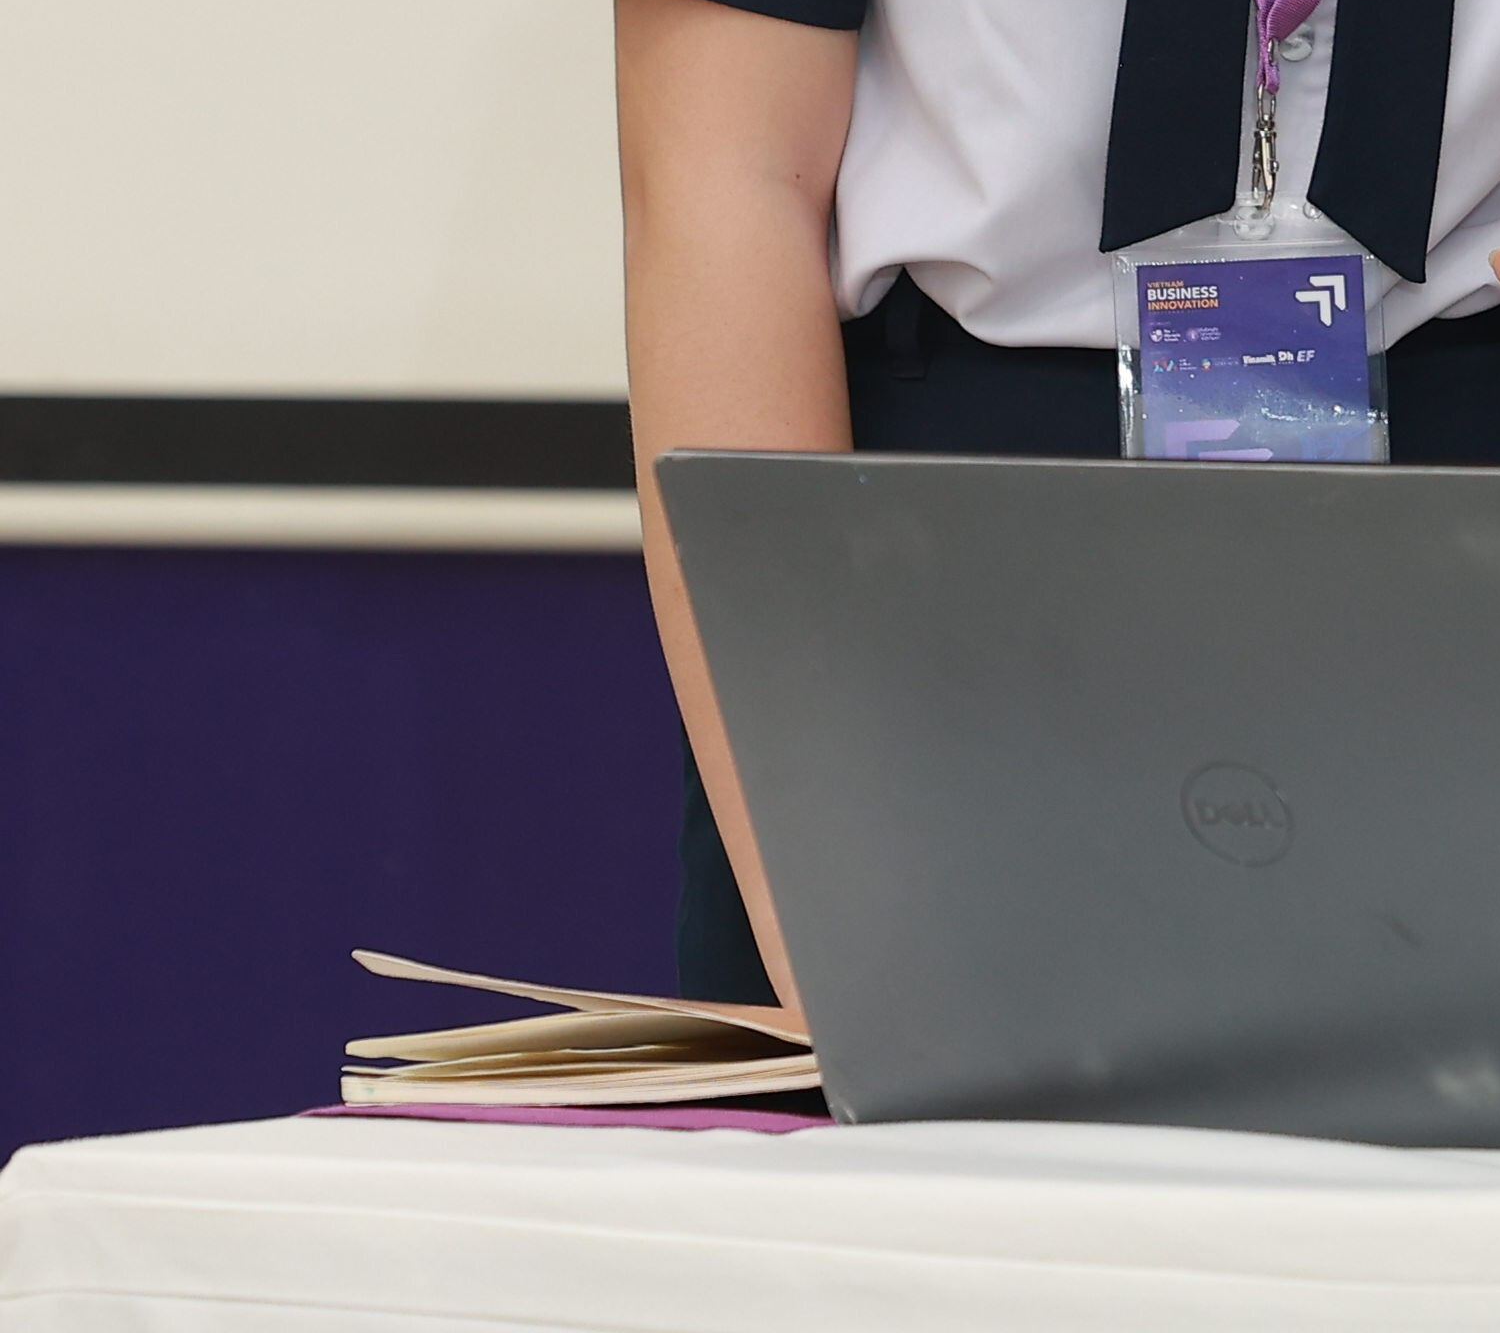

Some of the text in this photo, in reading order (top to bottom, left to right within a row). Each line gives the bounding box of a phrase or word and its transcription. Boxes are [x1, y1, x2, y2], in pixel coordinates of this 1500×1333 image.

[1147, 286, 1218, 301] BUSINESS
[1148, 299, 1219, 310] INNOVATION
[1296, 349, 1315, 362] EF
